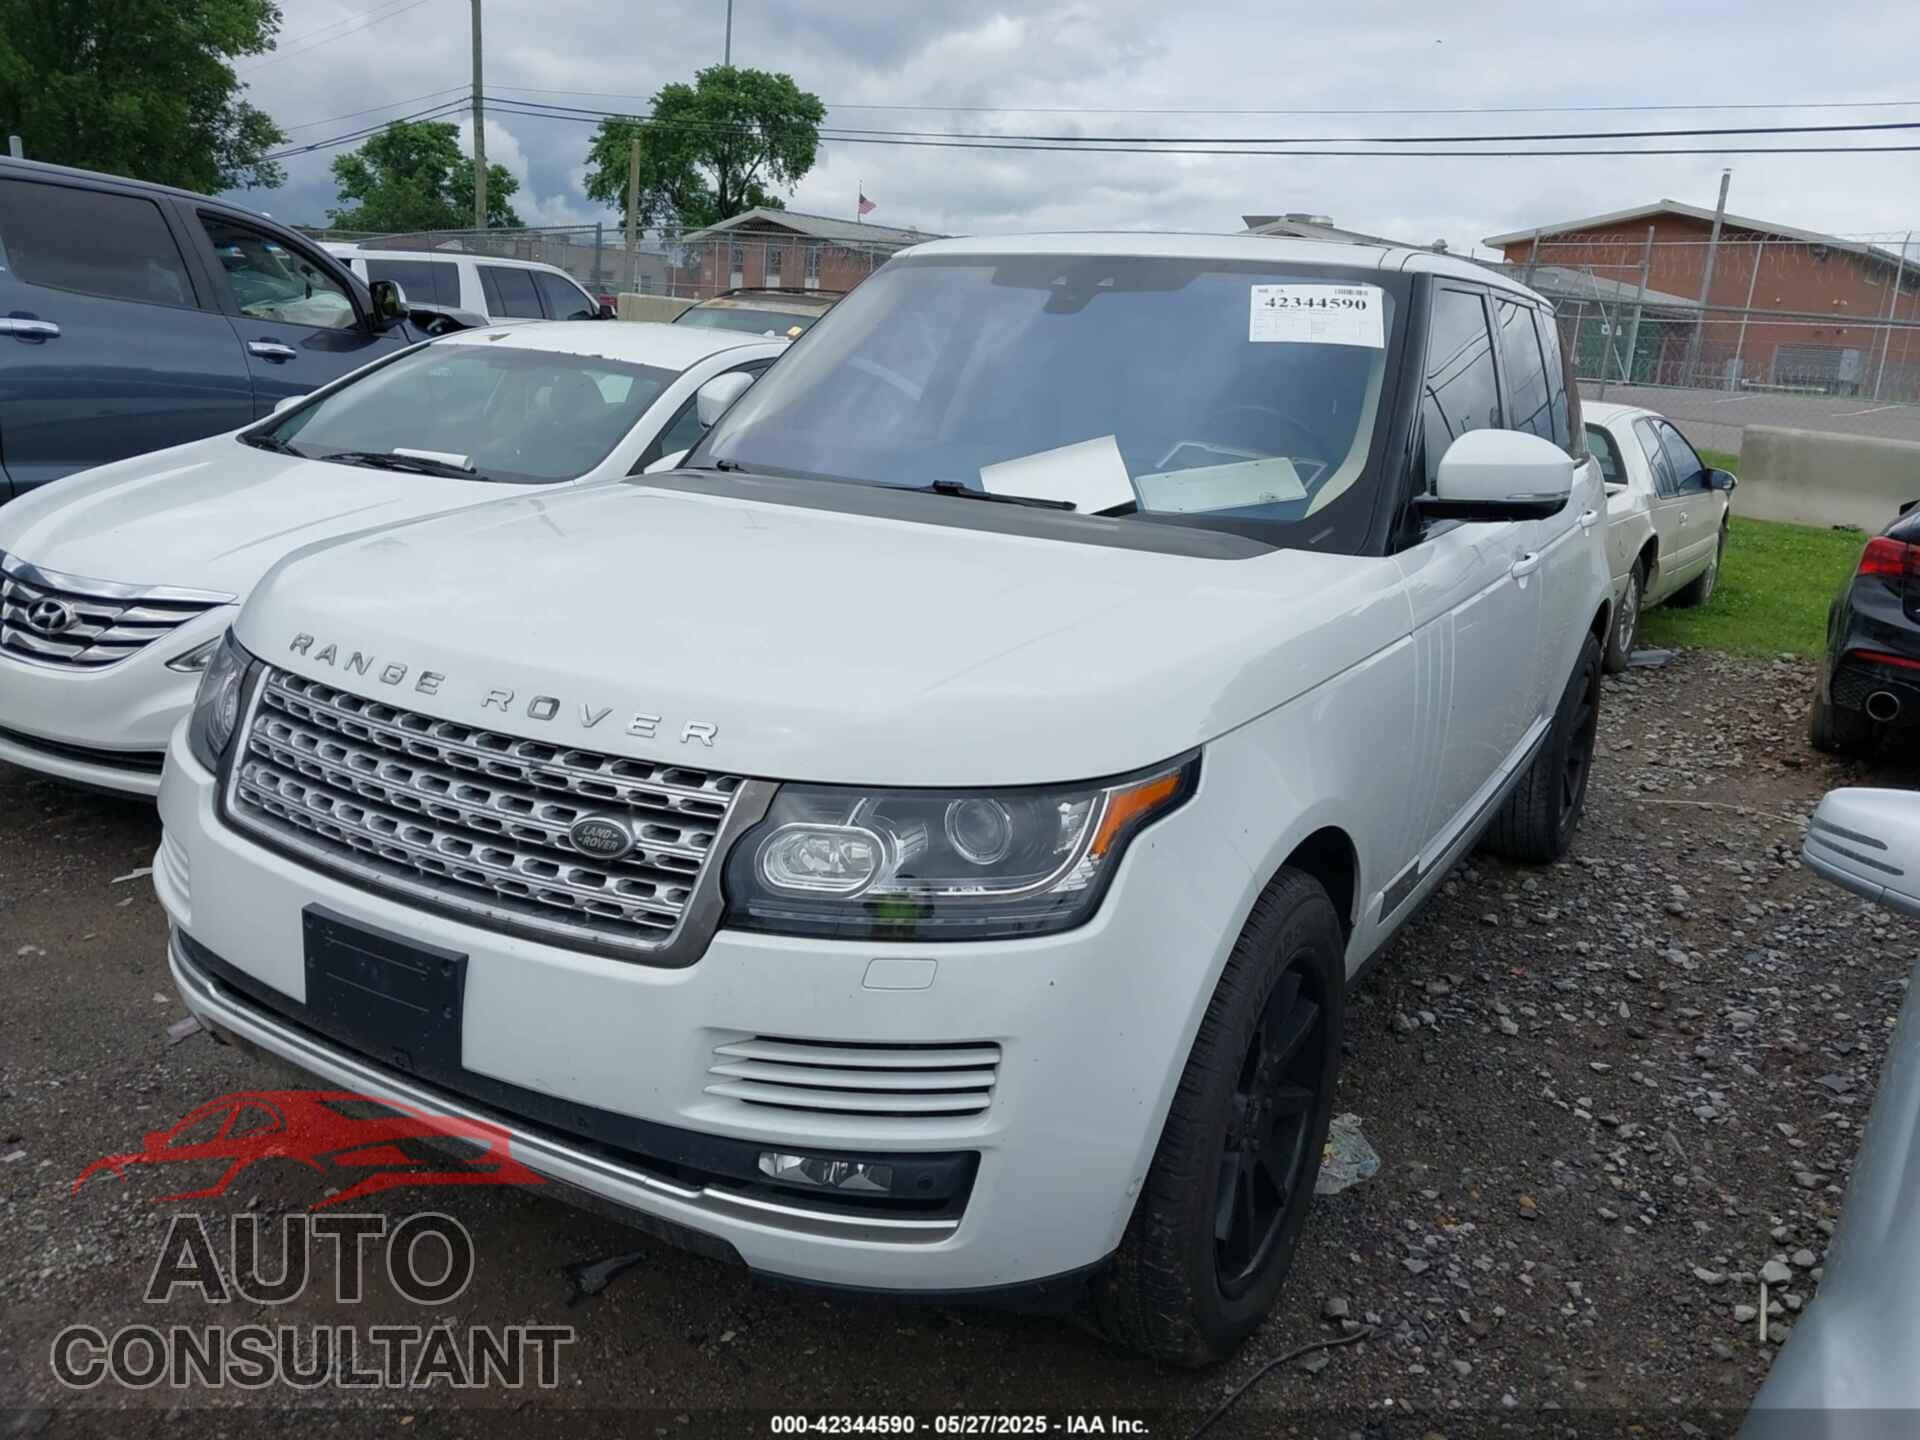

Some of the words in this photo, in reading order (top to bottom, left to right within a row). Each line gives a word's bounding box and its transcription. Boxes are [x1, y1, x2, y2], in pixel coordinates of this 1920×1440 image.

[1264, 297, 1367, 311] 42344590
[288, 632, 446, 695] RANGE
[479, 687, 719, 747] ROVER
[582, 825, 612, 839] LAND
[582, 836, 619, 851] ROVER
